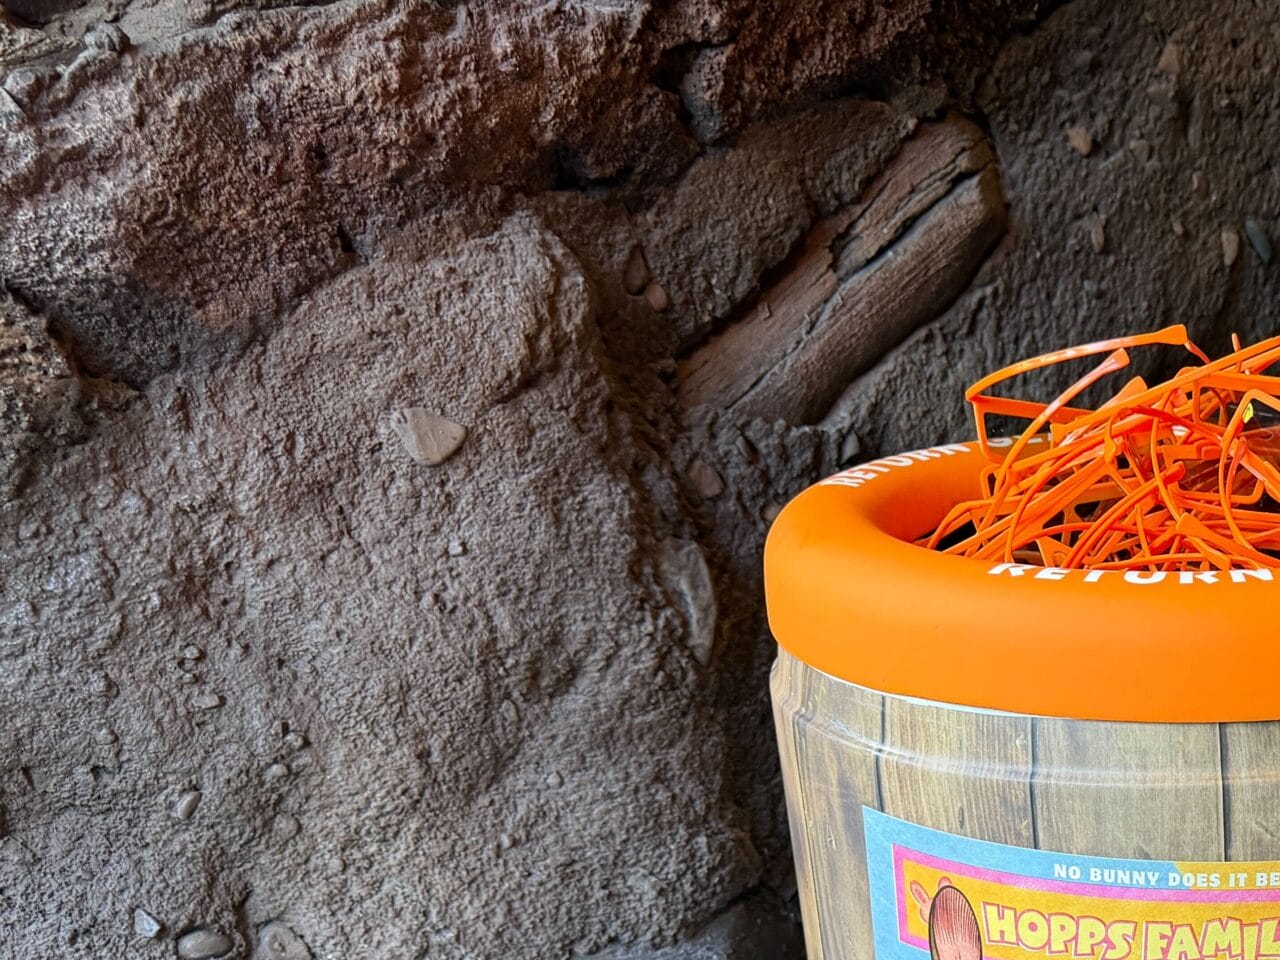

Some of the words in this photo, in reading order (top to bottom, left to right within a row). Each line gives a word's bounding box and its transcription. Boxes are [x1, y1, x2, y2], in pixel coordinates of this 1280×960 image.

[988, 561, 1274, 584] RETURN
[1054, 863, 1081, 879] NO
[1089, 867, 1160, 886] BUNNY
[1168, 872, 1221, 888] DOES
[1229, 873, 1248, 887] IT
